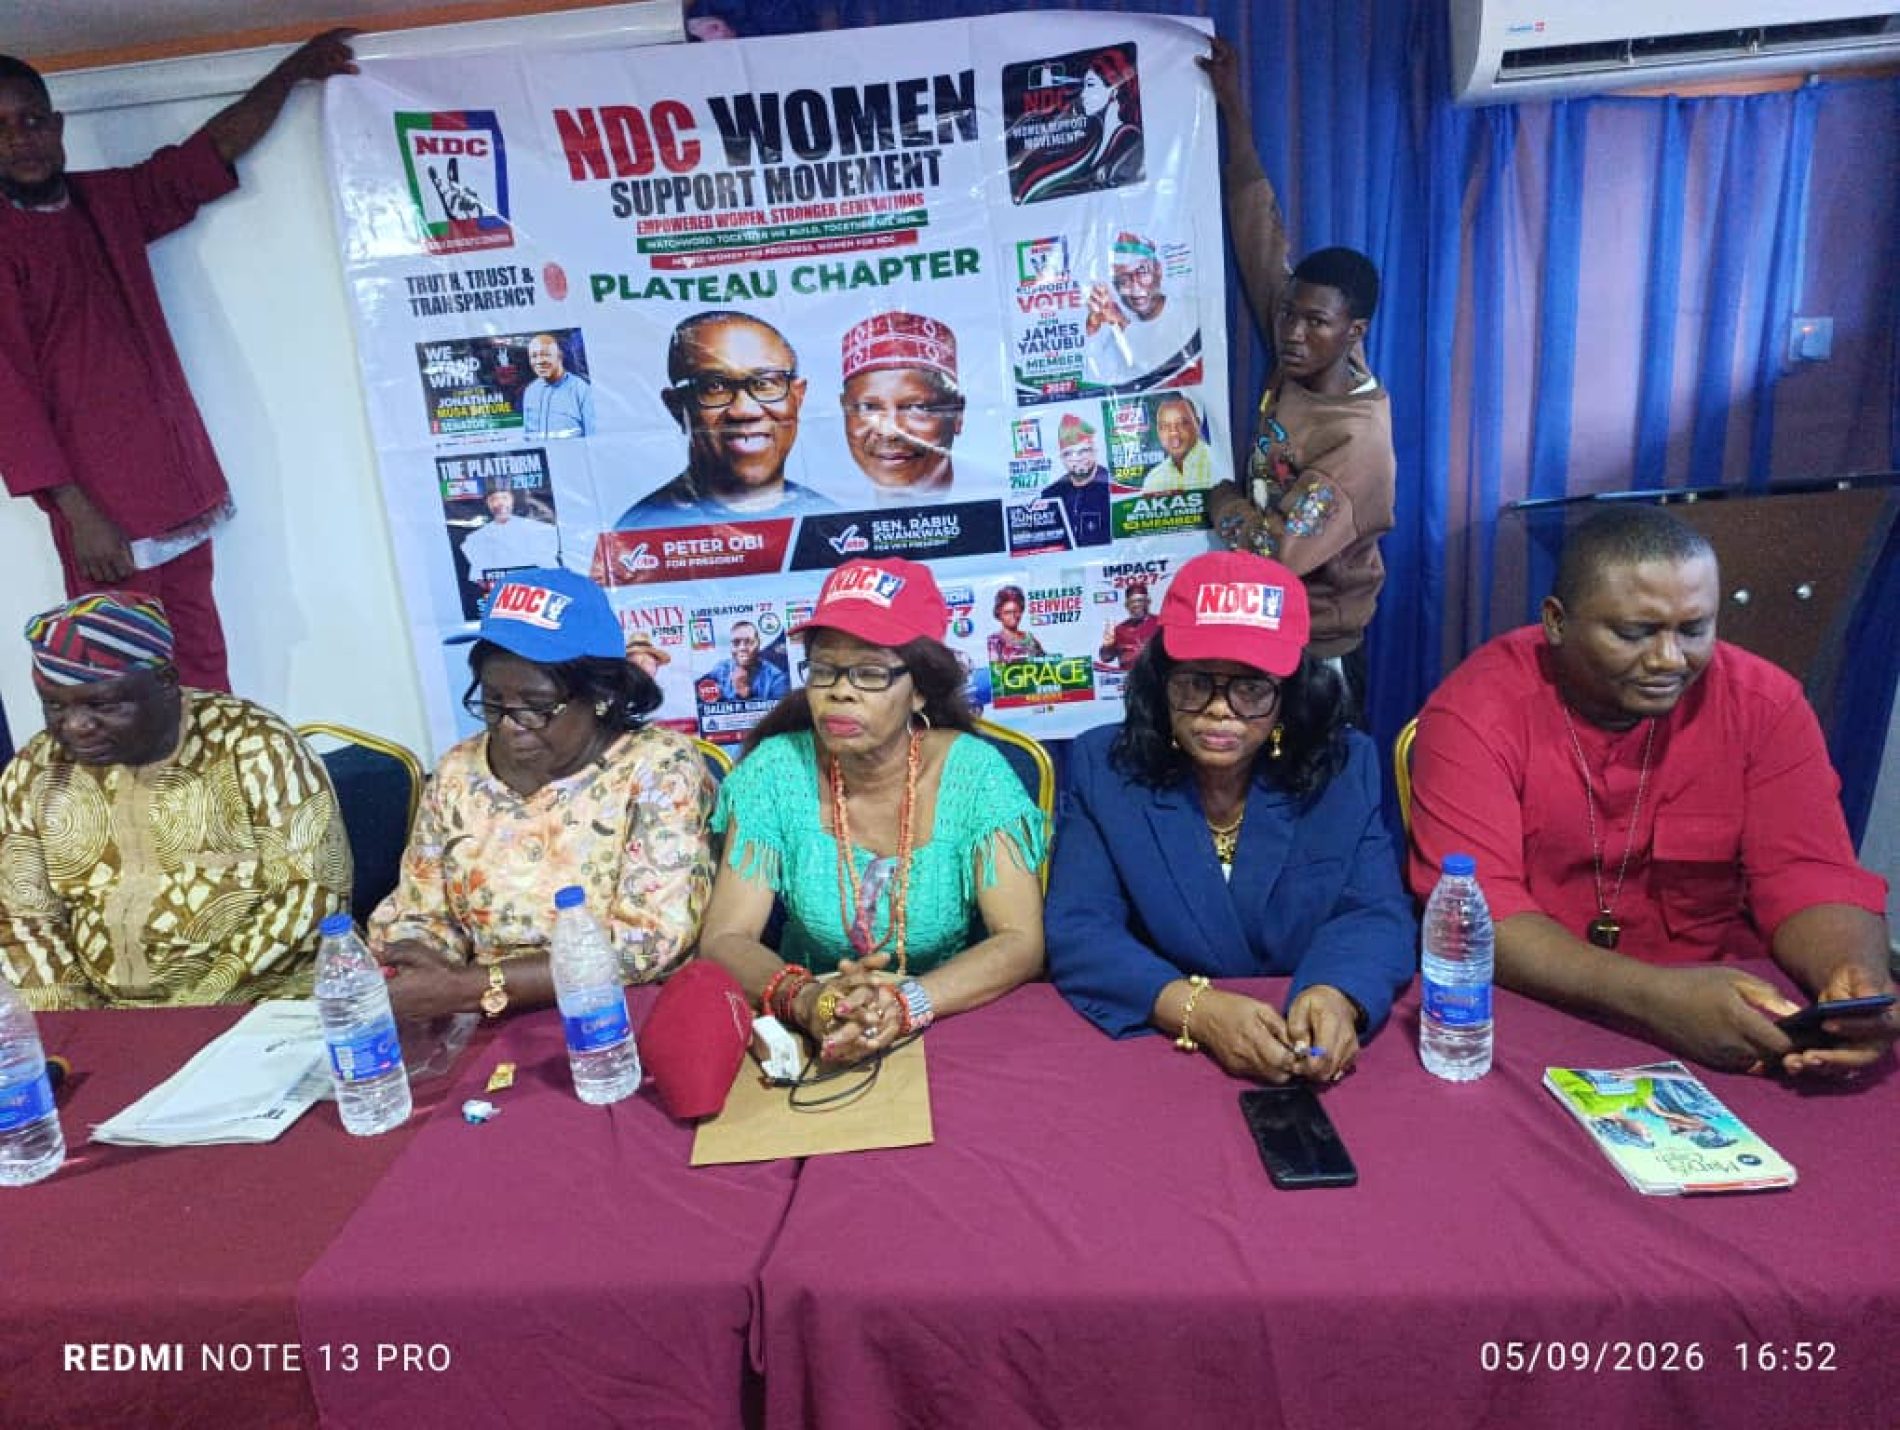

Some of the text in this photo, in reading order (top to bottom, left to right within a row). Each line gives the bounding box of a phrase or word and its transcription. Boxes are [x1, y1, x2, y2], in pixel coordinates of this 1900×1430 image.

[553, 70, 978, 180] NDC WOMEN
[415, 136, 488, 156] NDC
[611, 150, 942, 218] SUPPORT MOVEMENT
[636, 214, 714, 235] EMPOWERED
[770, 203, 837, 224] STRONGER
[465, 266, 517, 290] TRUST
[590, 247, 979, 302] PLATEAU CHAPTER
[408, 286, 535, 317] TRANSPARENCY
[1016, 290, 1081, 313] VOTE
[1022, 323, 1079, 342] JAMES
[1018, 335, 1085, 355] YAKUBU
[439, 454, 541, 480] THE PLATFORM
[1133, 493, 1204, 513] AKAS
[909, 514, 958, 529] RABIU
[663, 534, 764, 556] PETER OBI
[1102, 559, 1169, 577] IMPACT
[830, 568, 877, 593] NDC
[496, 584, 547, 613] NDC
[1029, 597, 1083, 613] SERVICE
[1200, 584, 1260, 614] NDC
[619, 607, 685, 629] ANITY
[1052, 611, 1081, 624] 2027
[1004, 659, 1088, 688] GRACE
